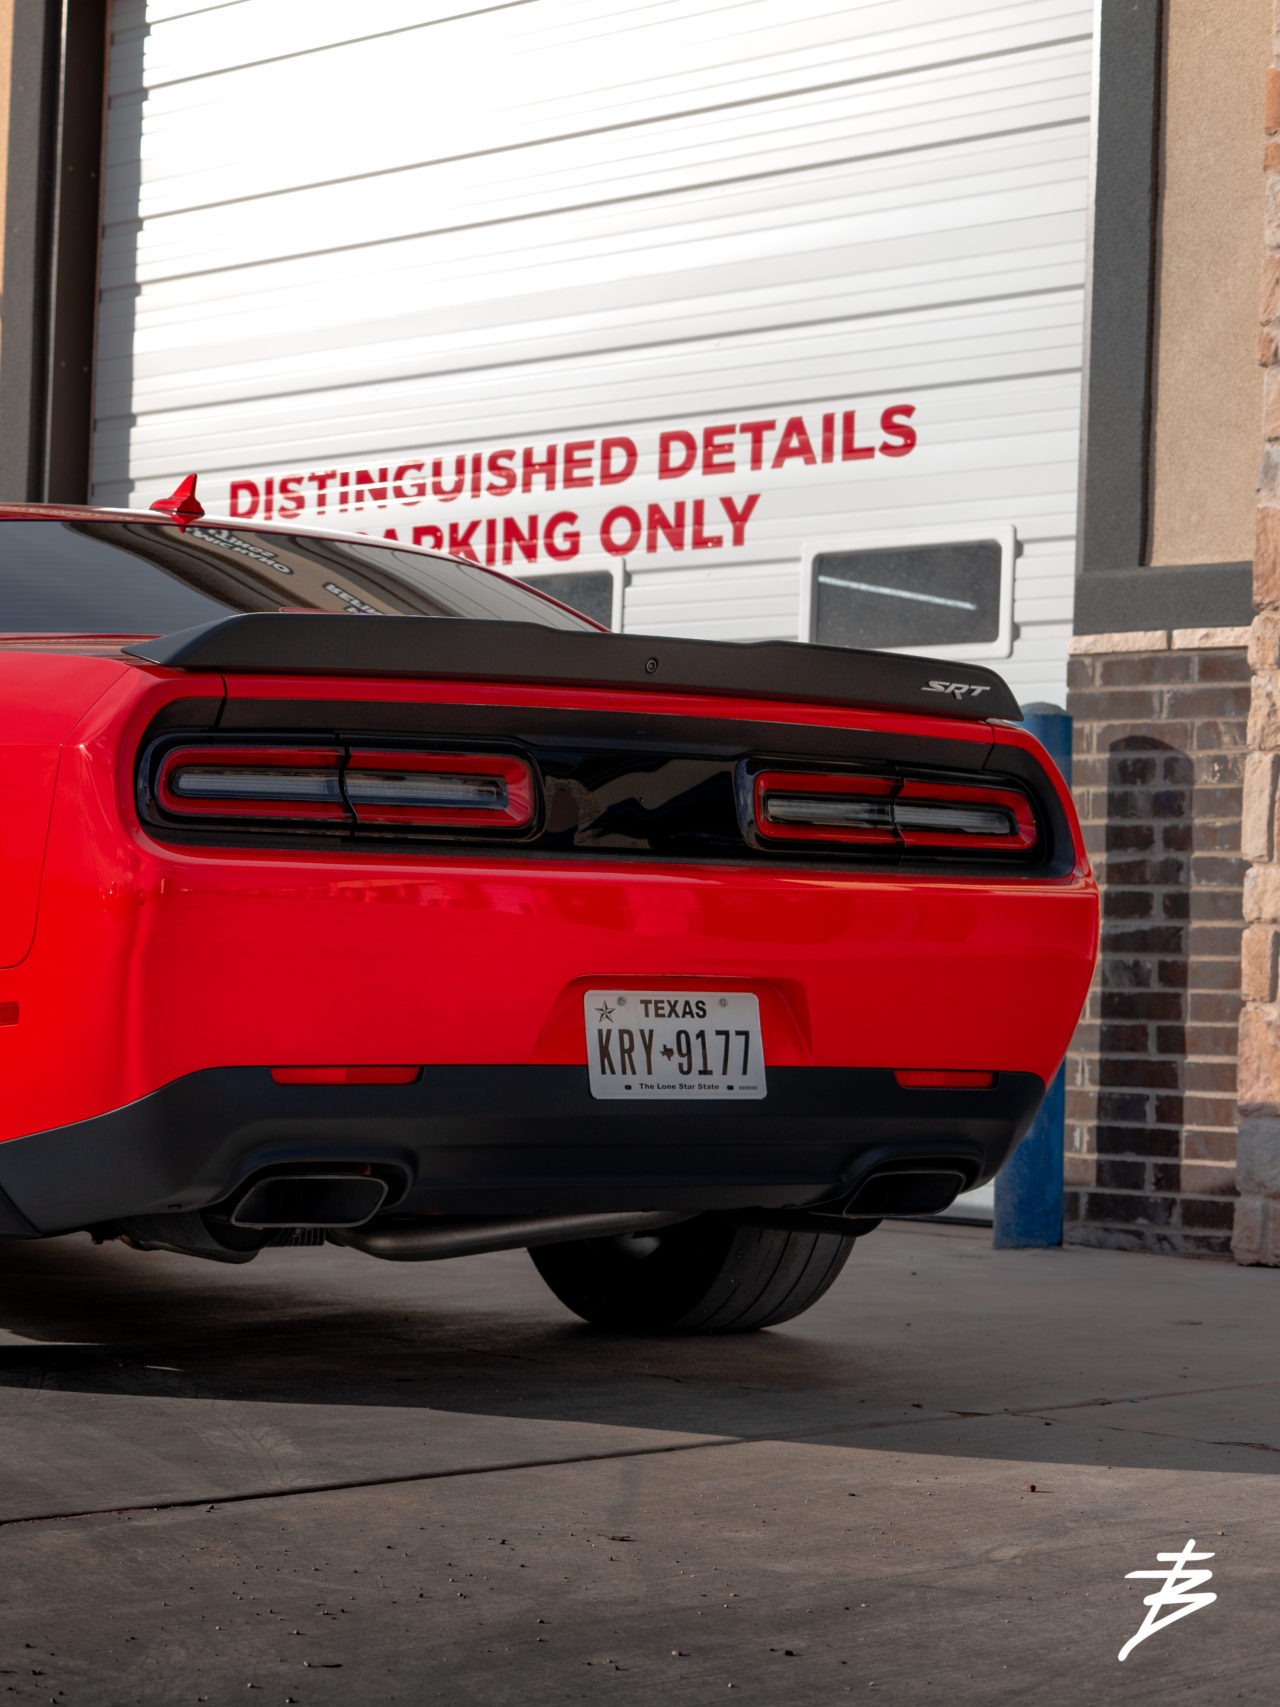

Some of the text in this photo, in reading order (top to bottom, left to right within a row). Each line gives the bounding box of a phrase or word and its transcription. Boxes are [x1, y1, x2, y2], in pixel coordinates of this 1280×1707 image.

[229, 404, 917, 521] DISTINGUISHED DETAILS
[600, 494, 761, 557] ONLY
[921, 680, 991, 700] SRT
[640, 999, 707, 1019] TEXAS
[676, 1029, 750, 1076] 9177
